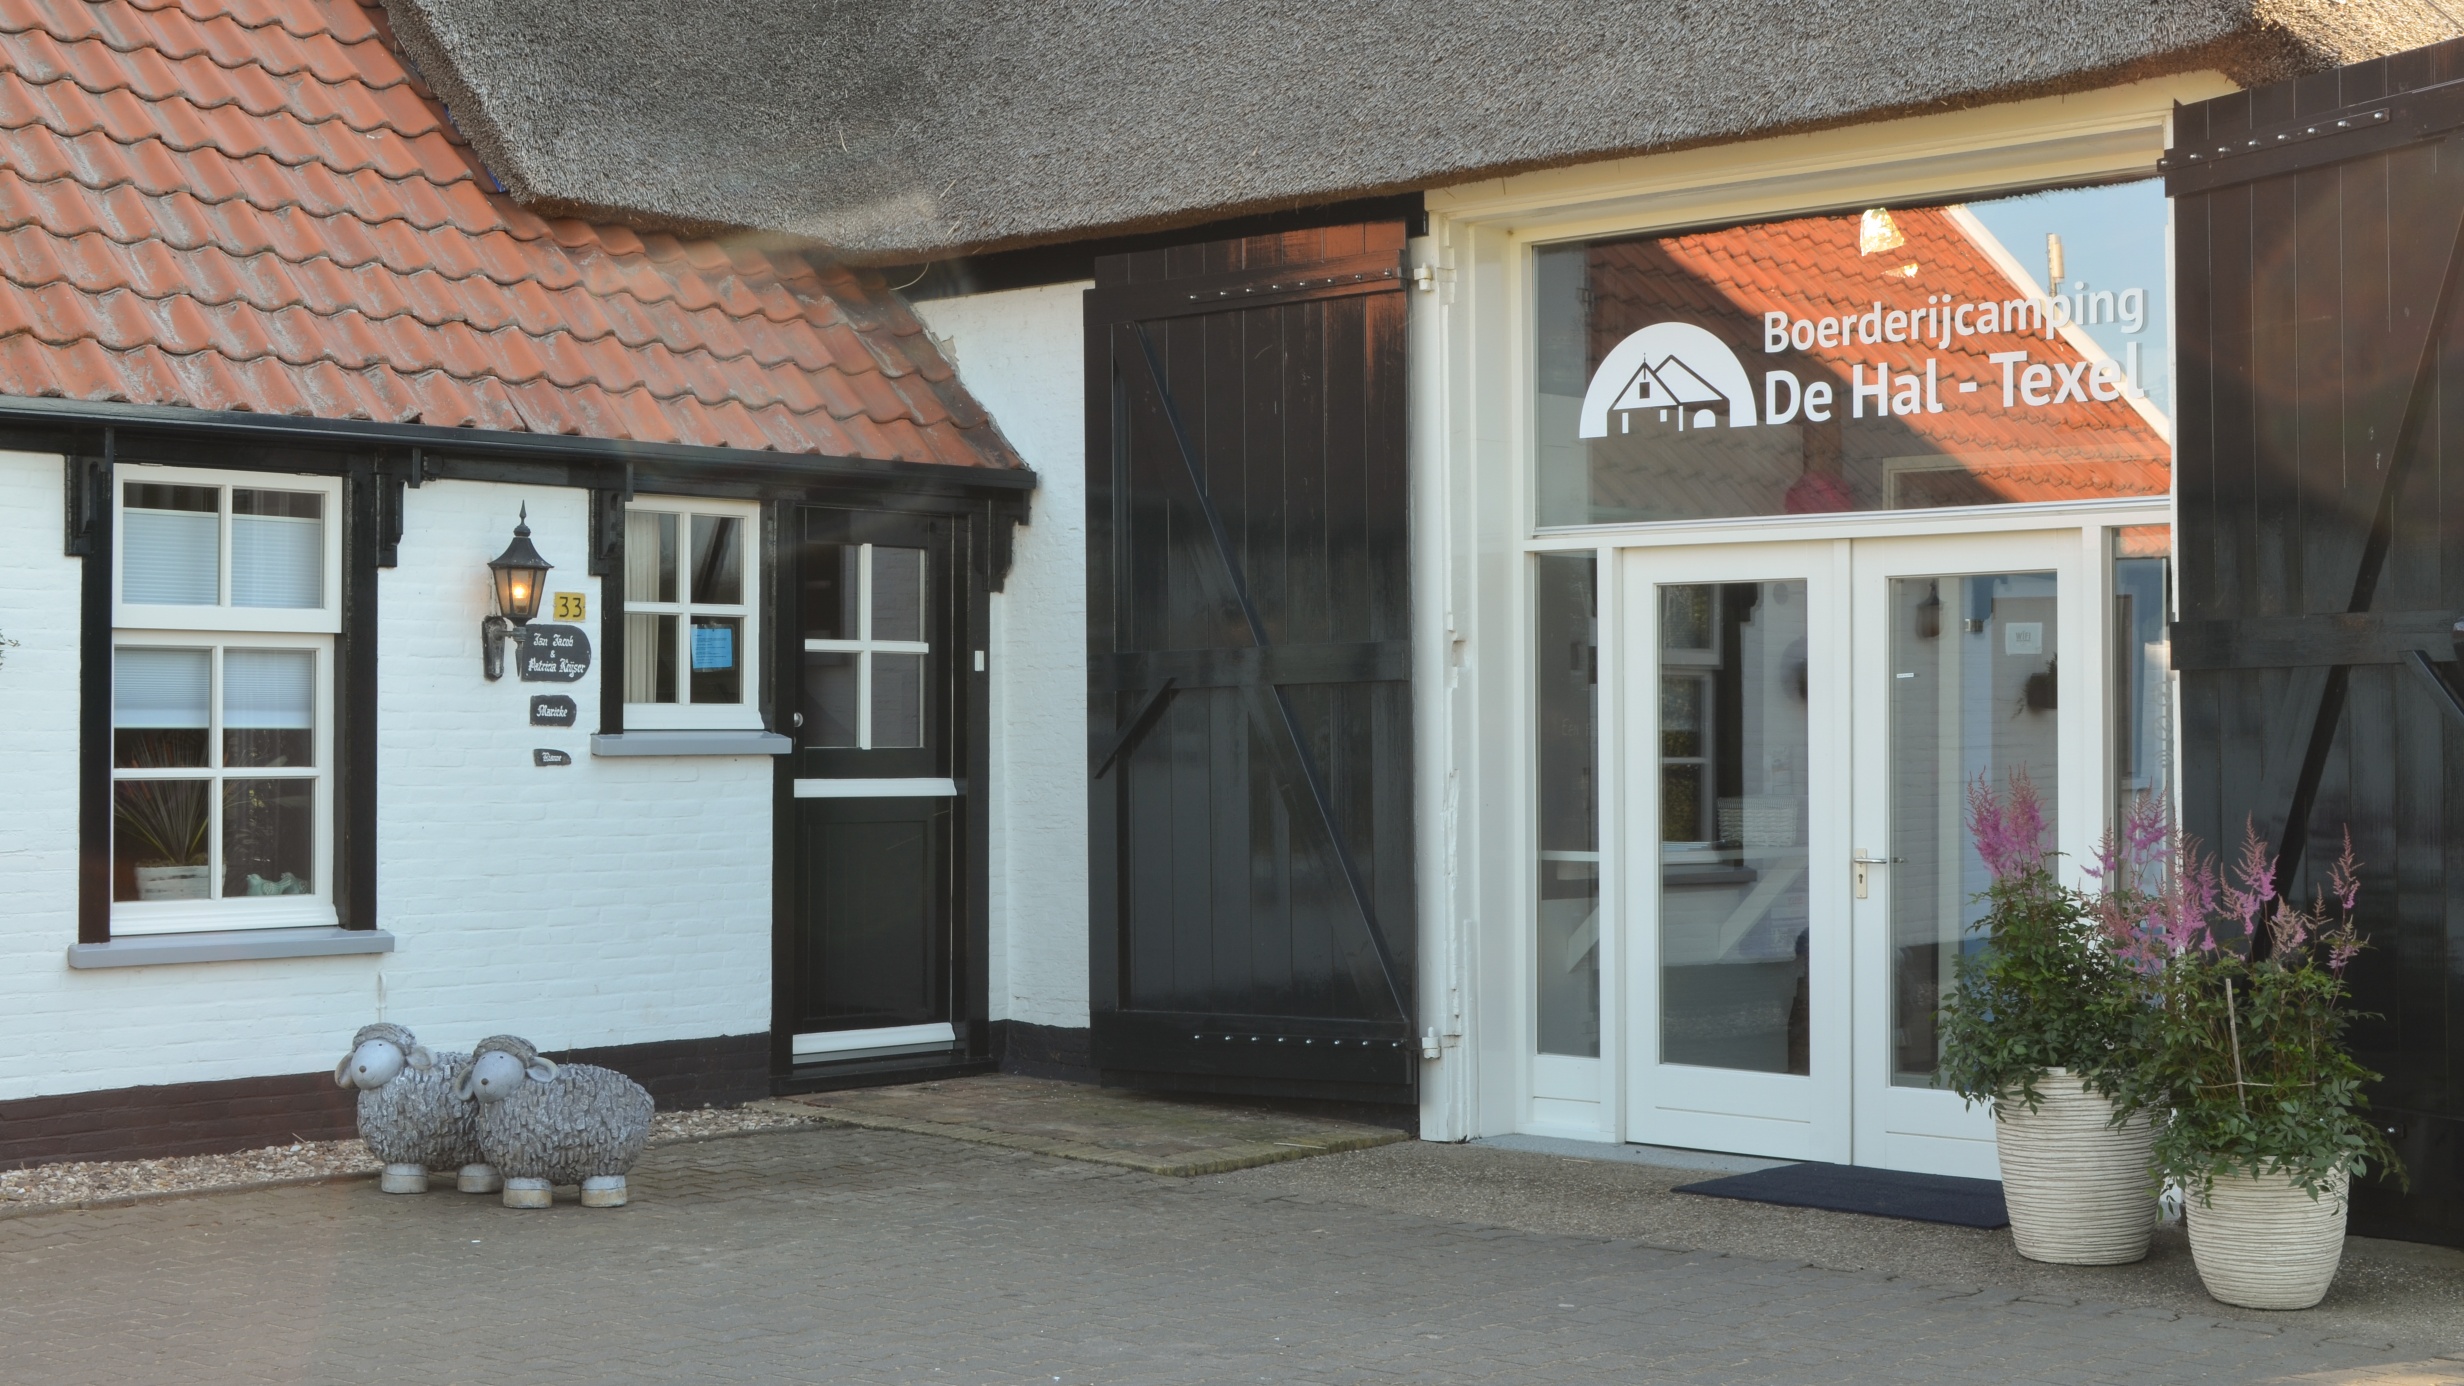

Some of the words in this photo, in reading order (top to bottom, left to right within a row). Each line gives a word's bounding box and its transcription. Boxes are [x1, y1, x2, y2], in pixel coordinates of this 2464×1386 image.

[1765, 281, 2144, 353] Boerderijcamping
[1766, 370, 1833, 425] De
[1853, 358, 1943, 419] Hal
[1959, 382, 1977, 393] -
[1989, 341, 2144, 408] Texel
[559, 596, 582, 618] 33
[528, 657, 557, 673] Patricia
[550, 649, 556, 659] &
